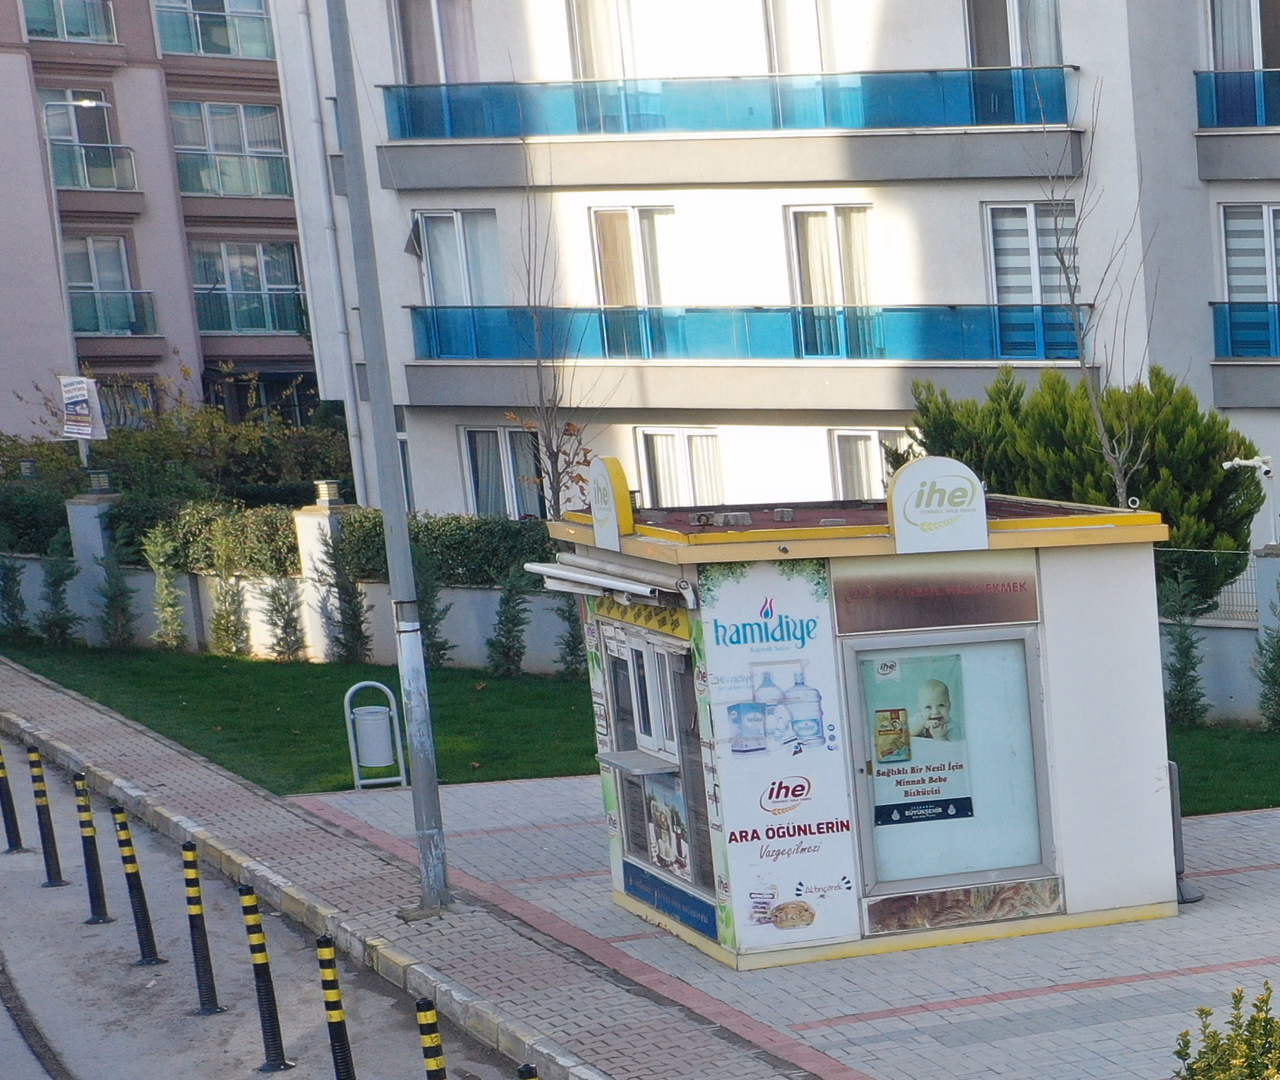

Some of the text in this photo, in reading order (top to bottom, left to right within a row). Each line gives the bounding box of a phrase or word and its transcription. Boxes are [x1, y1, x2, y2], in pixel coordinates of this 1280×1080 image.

[915, 481, 969, 509] ihe
[985, 581, 1028, 594] EKMEK
[876, 761, 964, 778] Sağlıklı Bir Nesil İçin
[928, 775, 948, 784] Bebe
[768, 781, 806, 800] ihe
[728, 817, 851, 844] ARA ÖĞÜNLERİN
[759, 841, 823, 862] Vazgeçilmezi
